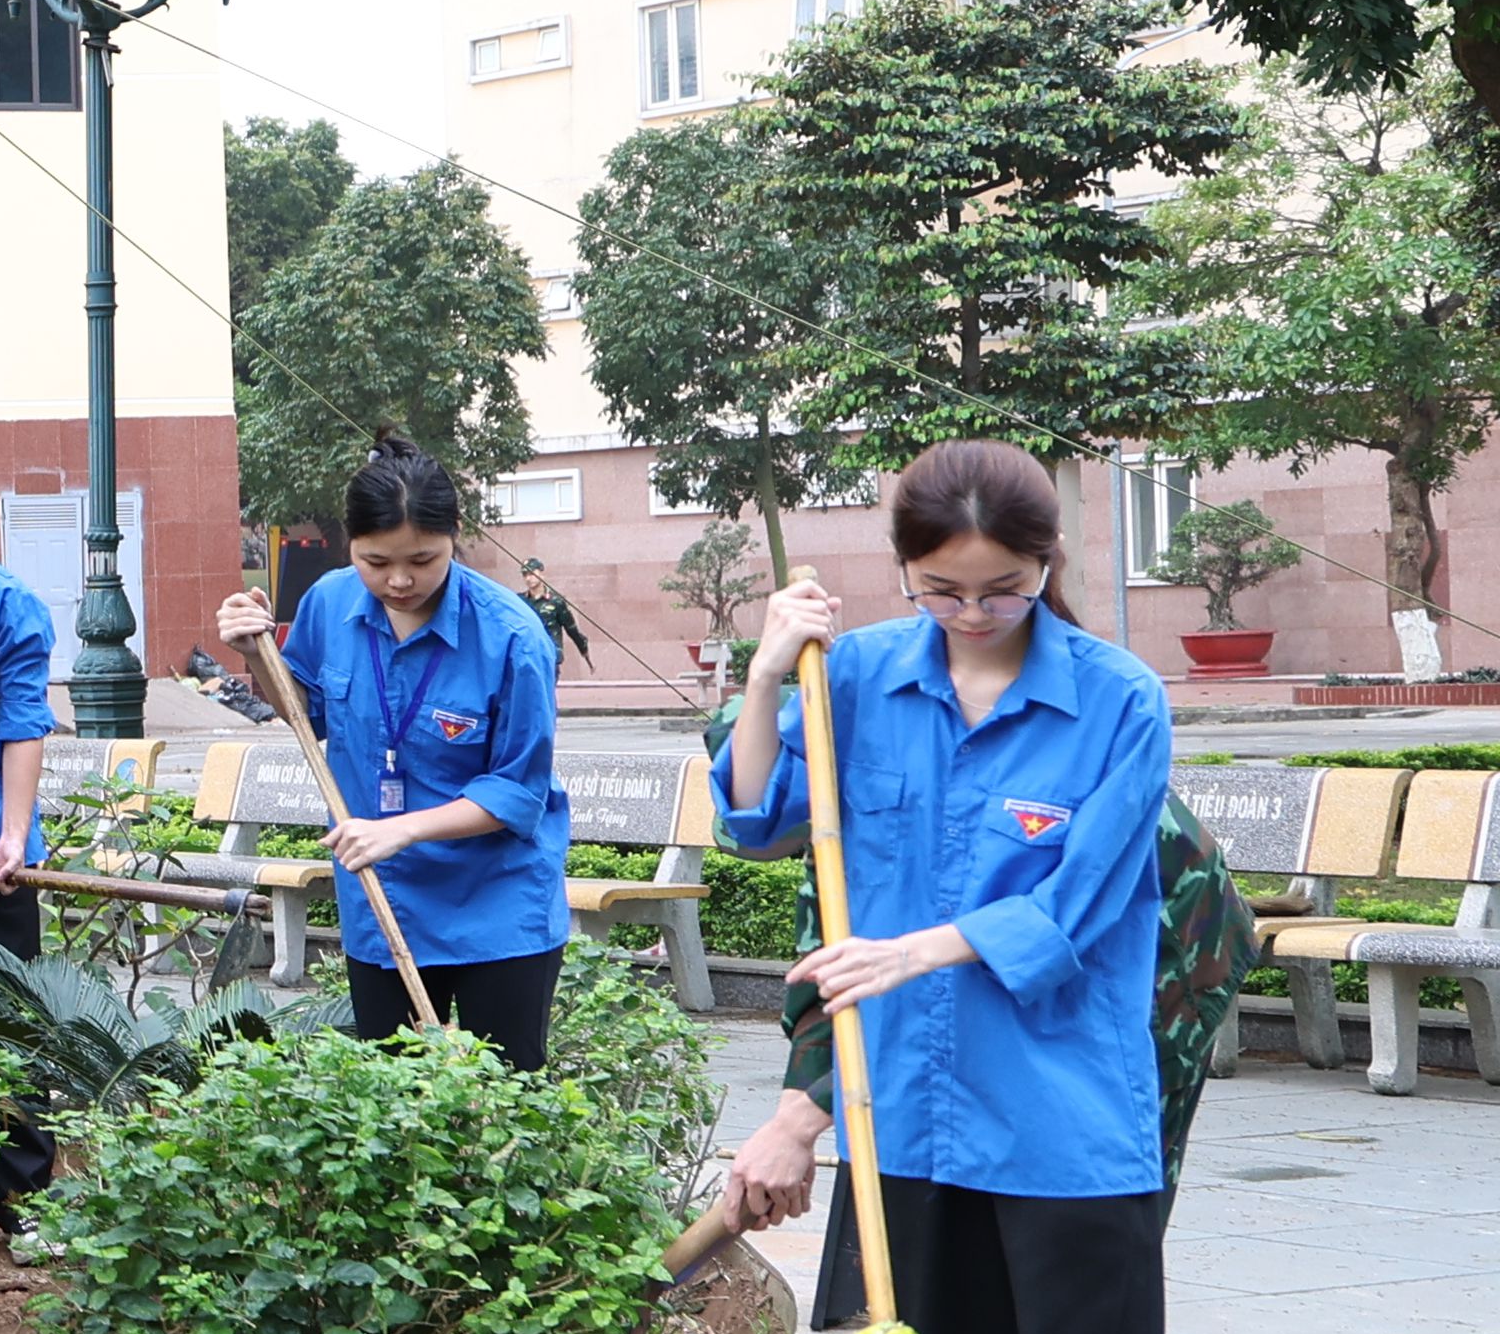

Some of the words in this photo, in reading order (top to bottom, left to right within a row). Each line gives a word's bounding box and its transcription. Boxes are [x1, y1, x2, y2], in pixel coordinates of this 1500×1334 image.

[653, 780, 661, 799] 3
[1192, 782, 1224, 818] TIỂU
[1226, 790, 1269, 820] ĐOÀN
[1271, 796, 1282, 820] 3
